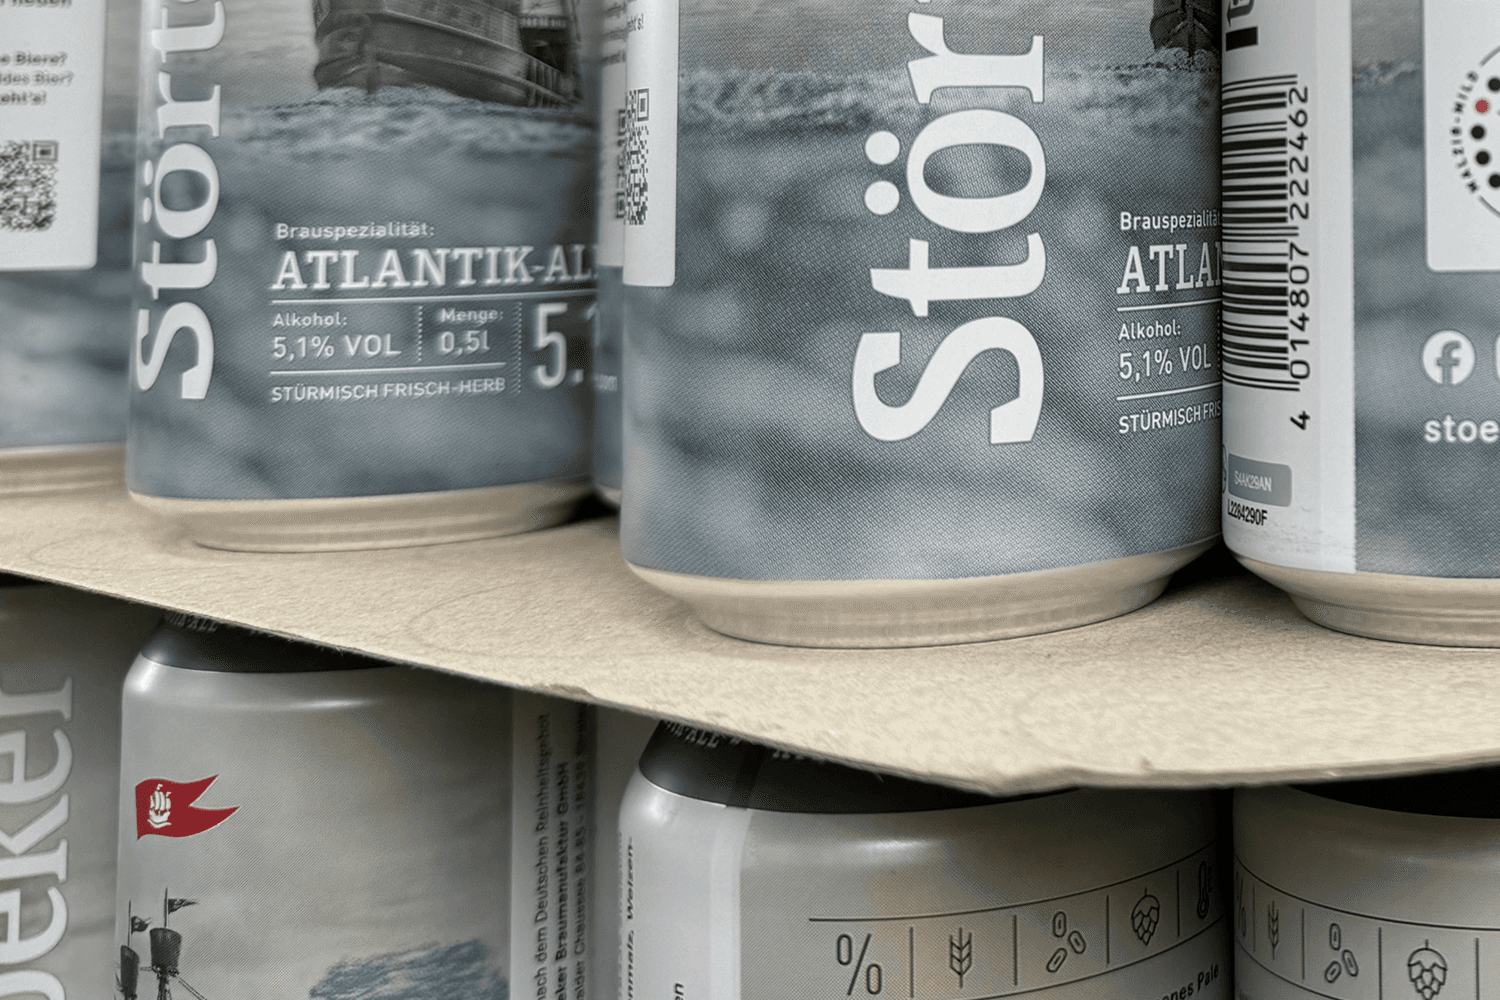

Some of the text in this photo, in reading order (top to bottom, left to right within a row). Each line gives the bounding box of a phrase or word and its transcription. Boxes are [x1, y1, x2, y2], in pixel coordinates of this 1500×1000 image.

[276, 222, 435, 241] Brauspezialität:
[1120, 210, 1222, 233] Brauspezialität
[270, 245, 598, 290] ATLANTIK-AL
[1288, 85, 1311, 431] 4 014807 222462
[273, 312, 347, 327] Alkohol:
[440, 307, 504, 323] Menge:
[440, 329, 490, 357] 0,5l
[1118, 319, 1181, 341] Alkohol:
[273, 334, 401, 362] 5,1% VOL
[1119, 343, 1211, 382] 5,1% VOL
[271, 378, 506, 402] STÜRMISCH FRISCH-HERB
[1119, 405, 1201, 434] STÜRMISCH
[1197, 963, 1220, 992] Pale
